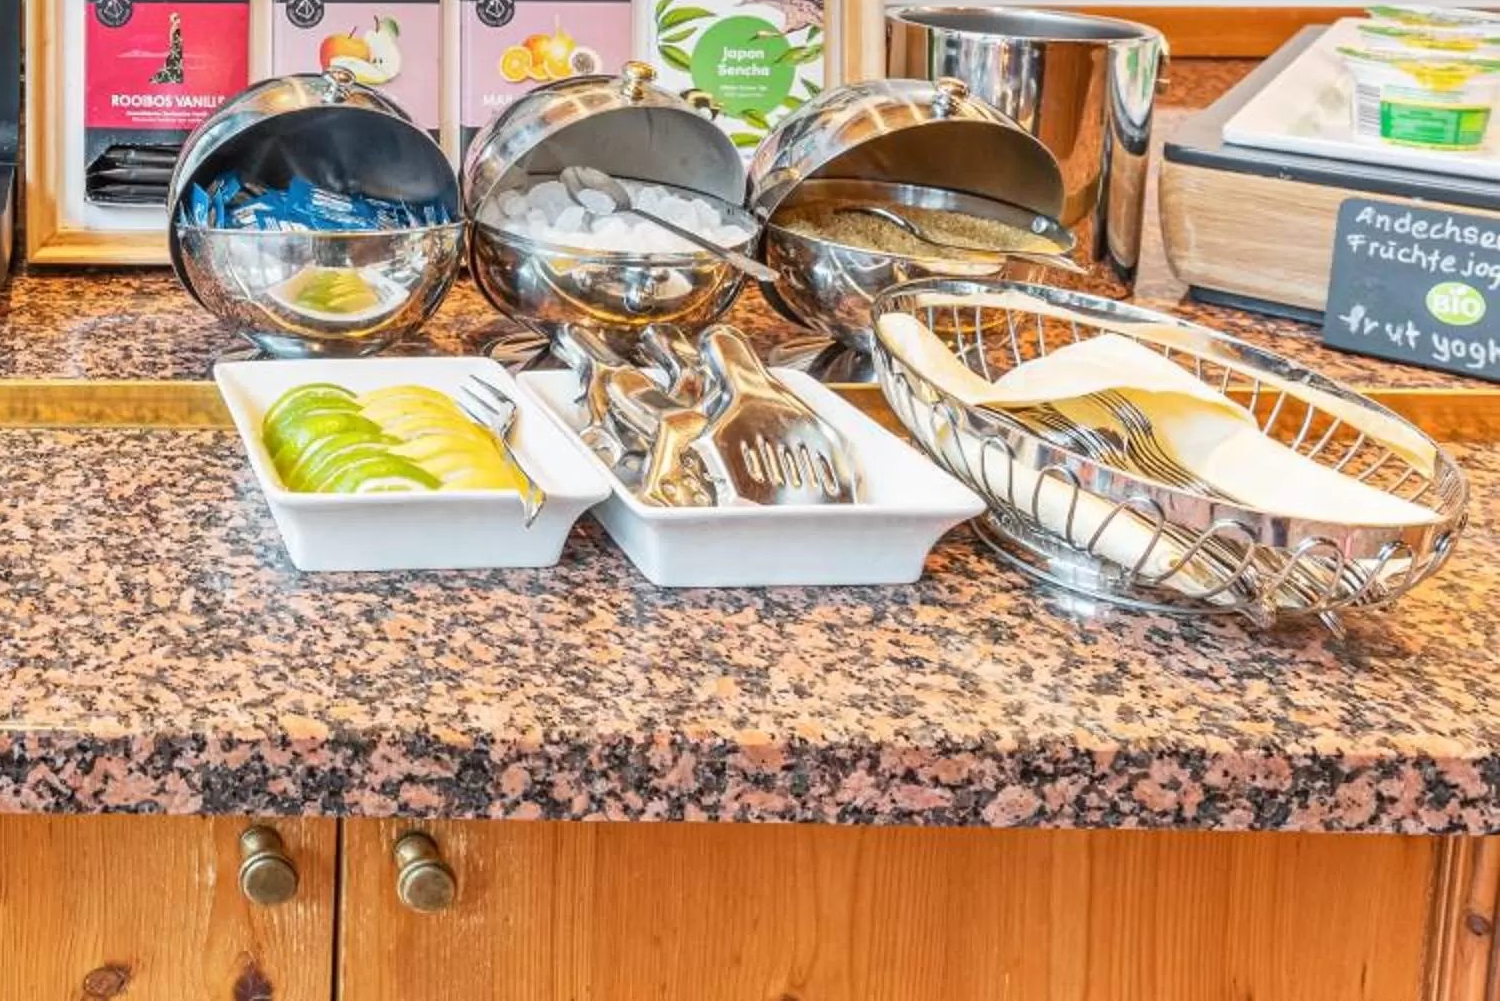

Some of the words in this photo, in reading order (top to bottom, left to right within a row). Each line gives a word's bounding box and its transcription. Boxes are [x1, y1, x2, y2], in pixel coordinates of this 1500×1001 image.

[721, 46, 765, 63] Japan
[717, 63, 771, 76] Sencha
[111, 94, 173, 108] ROOIBOS
[1434, 288, 1482, 318] BIO
